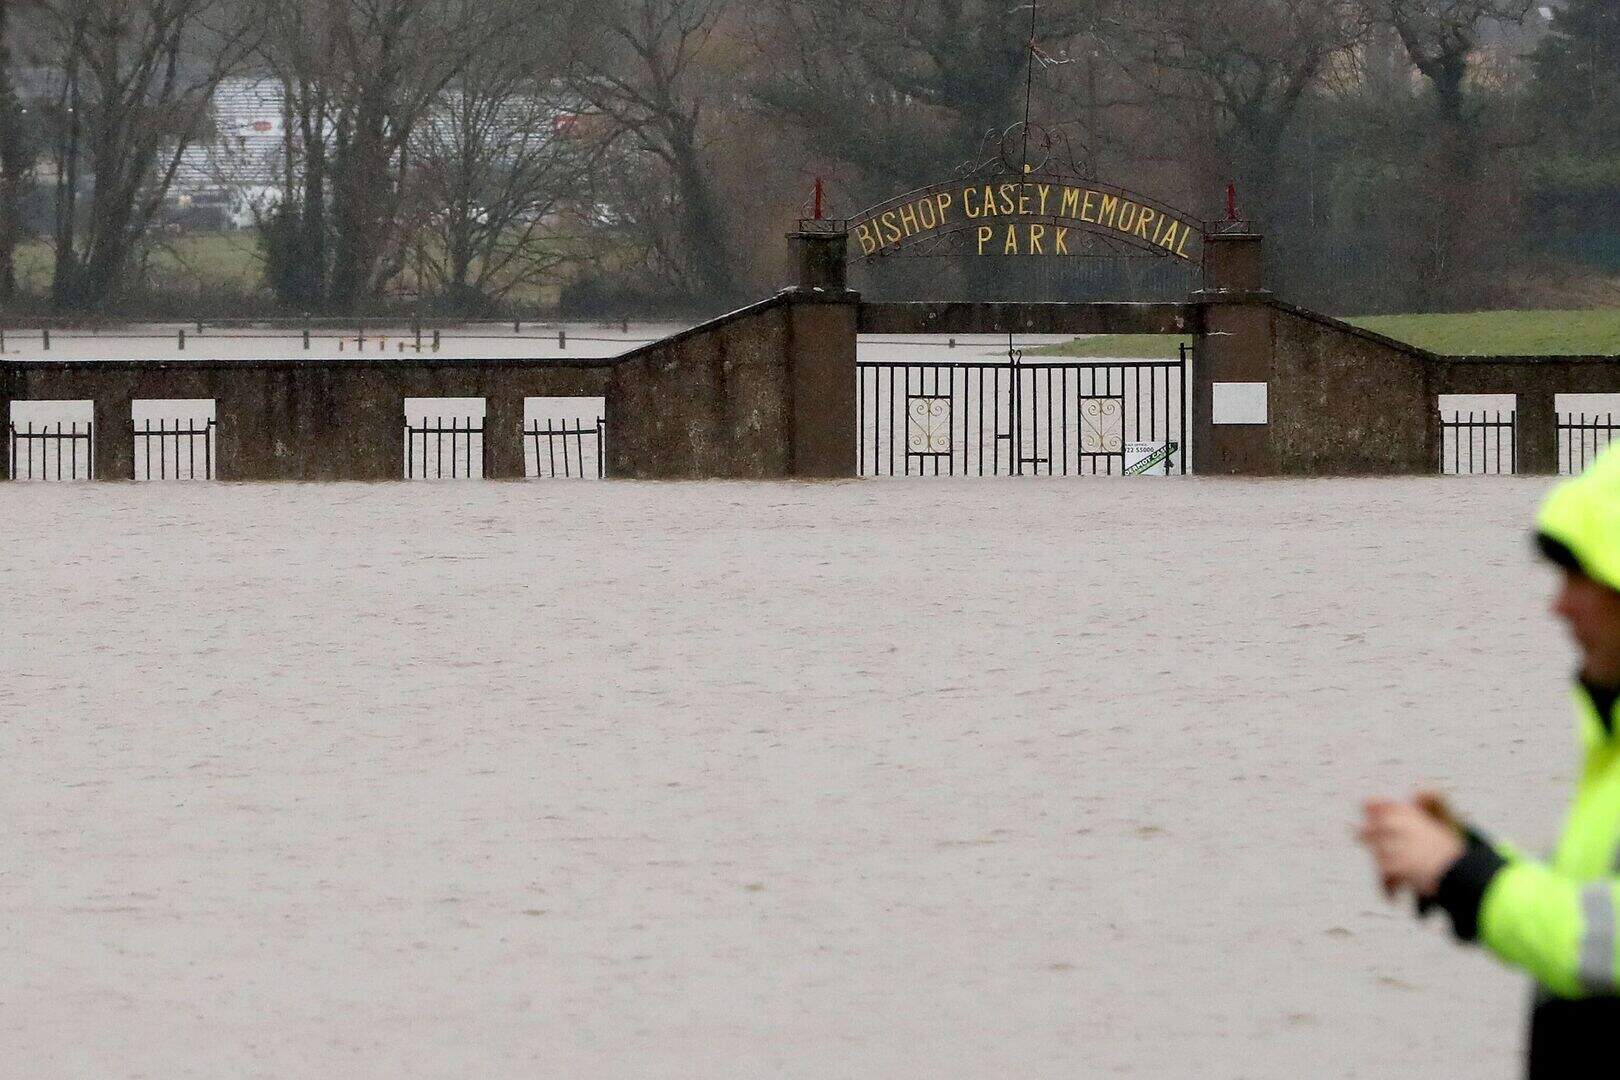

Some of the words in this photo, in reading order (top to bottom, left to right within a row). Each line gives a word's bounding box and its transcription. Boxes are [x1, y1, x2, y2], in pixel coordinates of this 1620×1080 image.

[855, 193, 952, 256] BISHOP
[963, 183, 1051, 219] CASEY
[1060, 186, 1191, 259] MEMORIAL
[978, 224, 1069, 256] PARK
